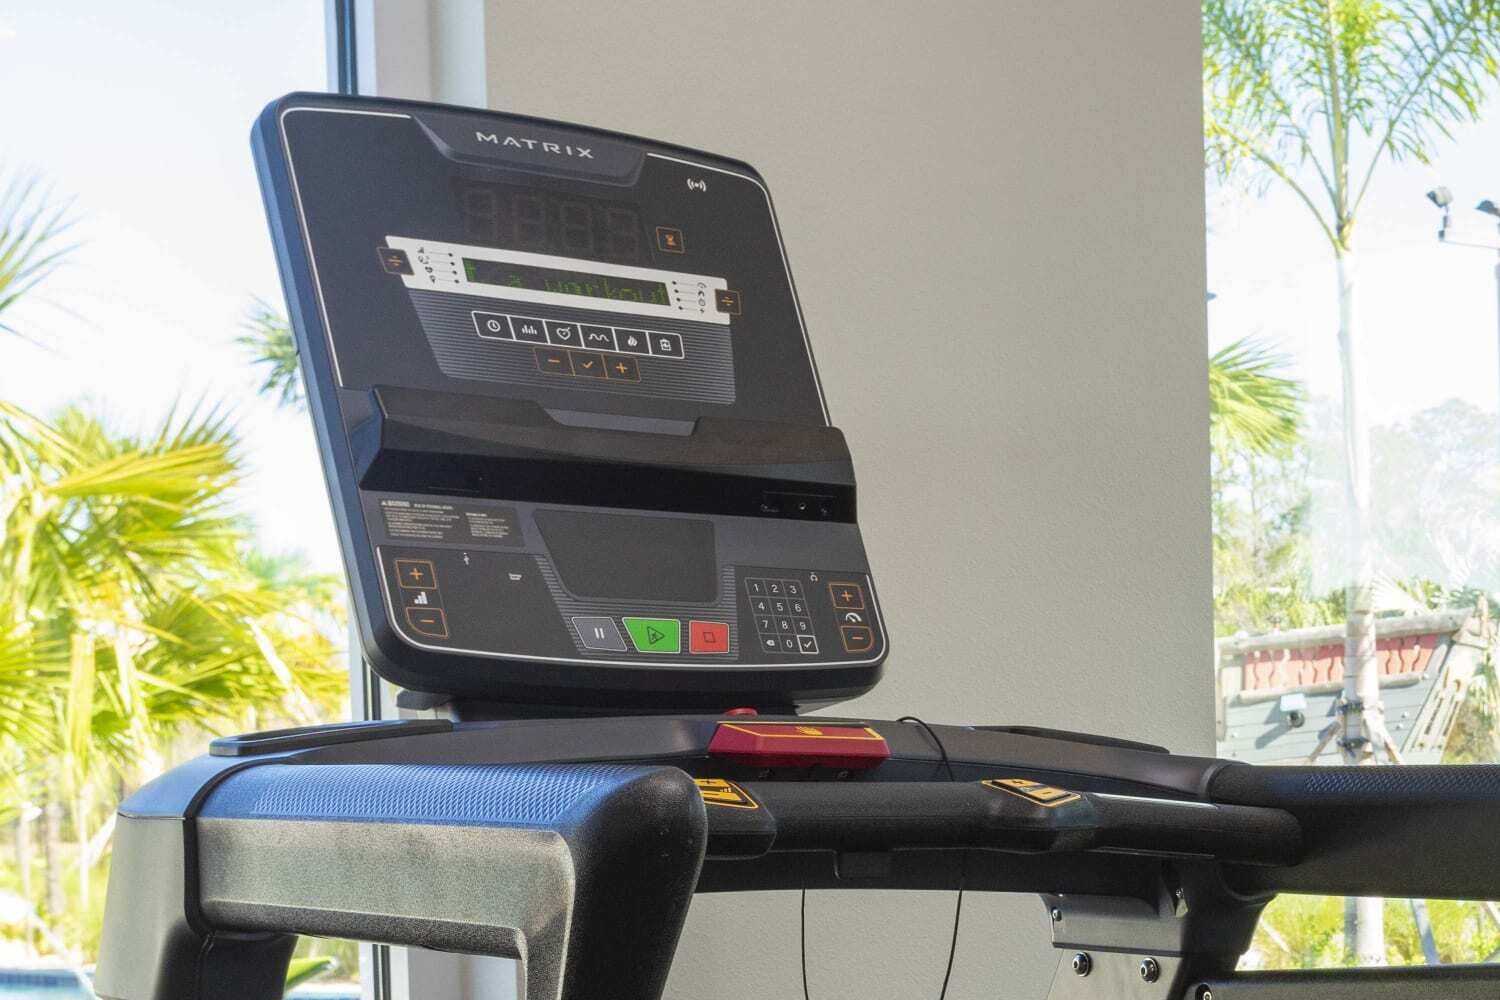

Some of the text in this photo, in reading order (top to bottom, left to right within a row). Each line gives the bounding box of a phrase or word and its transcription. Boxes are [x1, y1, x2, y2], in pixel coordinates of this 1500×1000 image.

[475, 131, 594, 159] MATRIX
[753, 583, 797, 594] 1 2 3
[758, 602, 802, 612] 4 5 6
[762, 620, 807, 631] 7 8 9
[786, 639, 793, 648] 0
